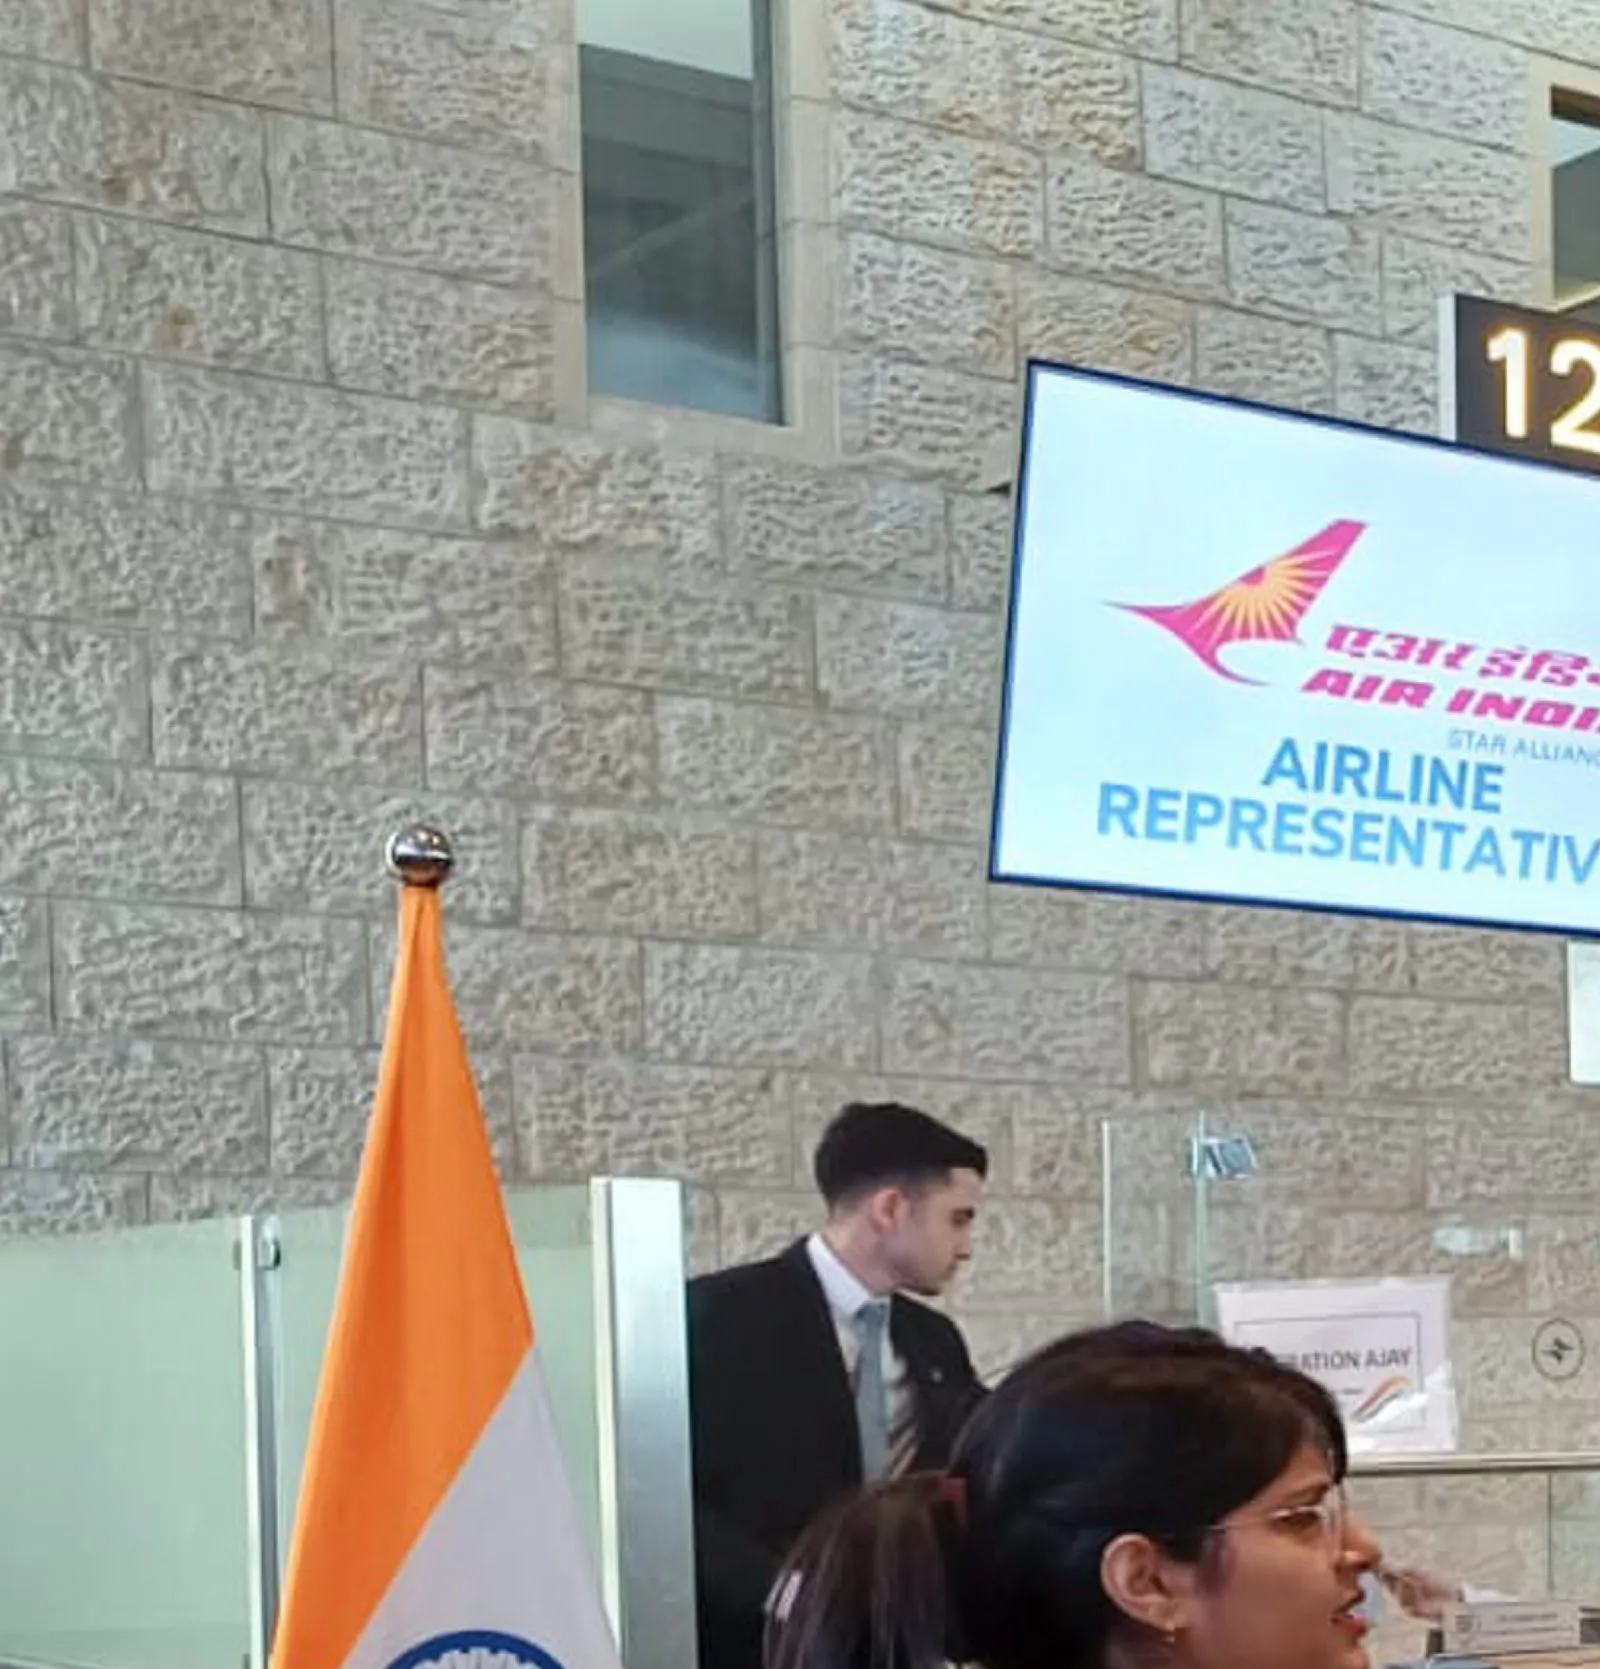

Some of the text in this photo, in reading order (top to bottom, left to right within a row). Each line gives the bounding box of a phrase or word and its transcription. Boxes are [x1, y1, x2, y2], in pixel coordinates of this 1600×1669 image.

[1300, 669, 1434, 708] AIR
[1447, 729, 1506, 754] STAR
[1262, 737, 1505, 814] AIRLINE
